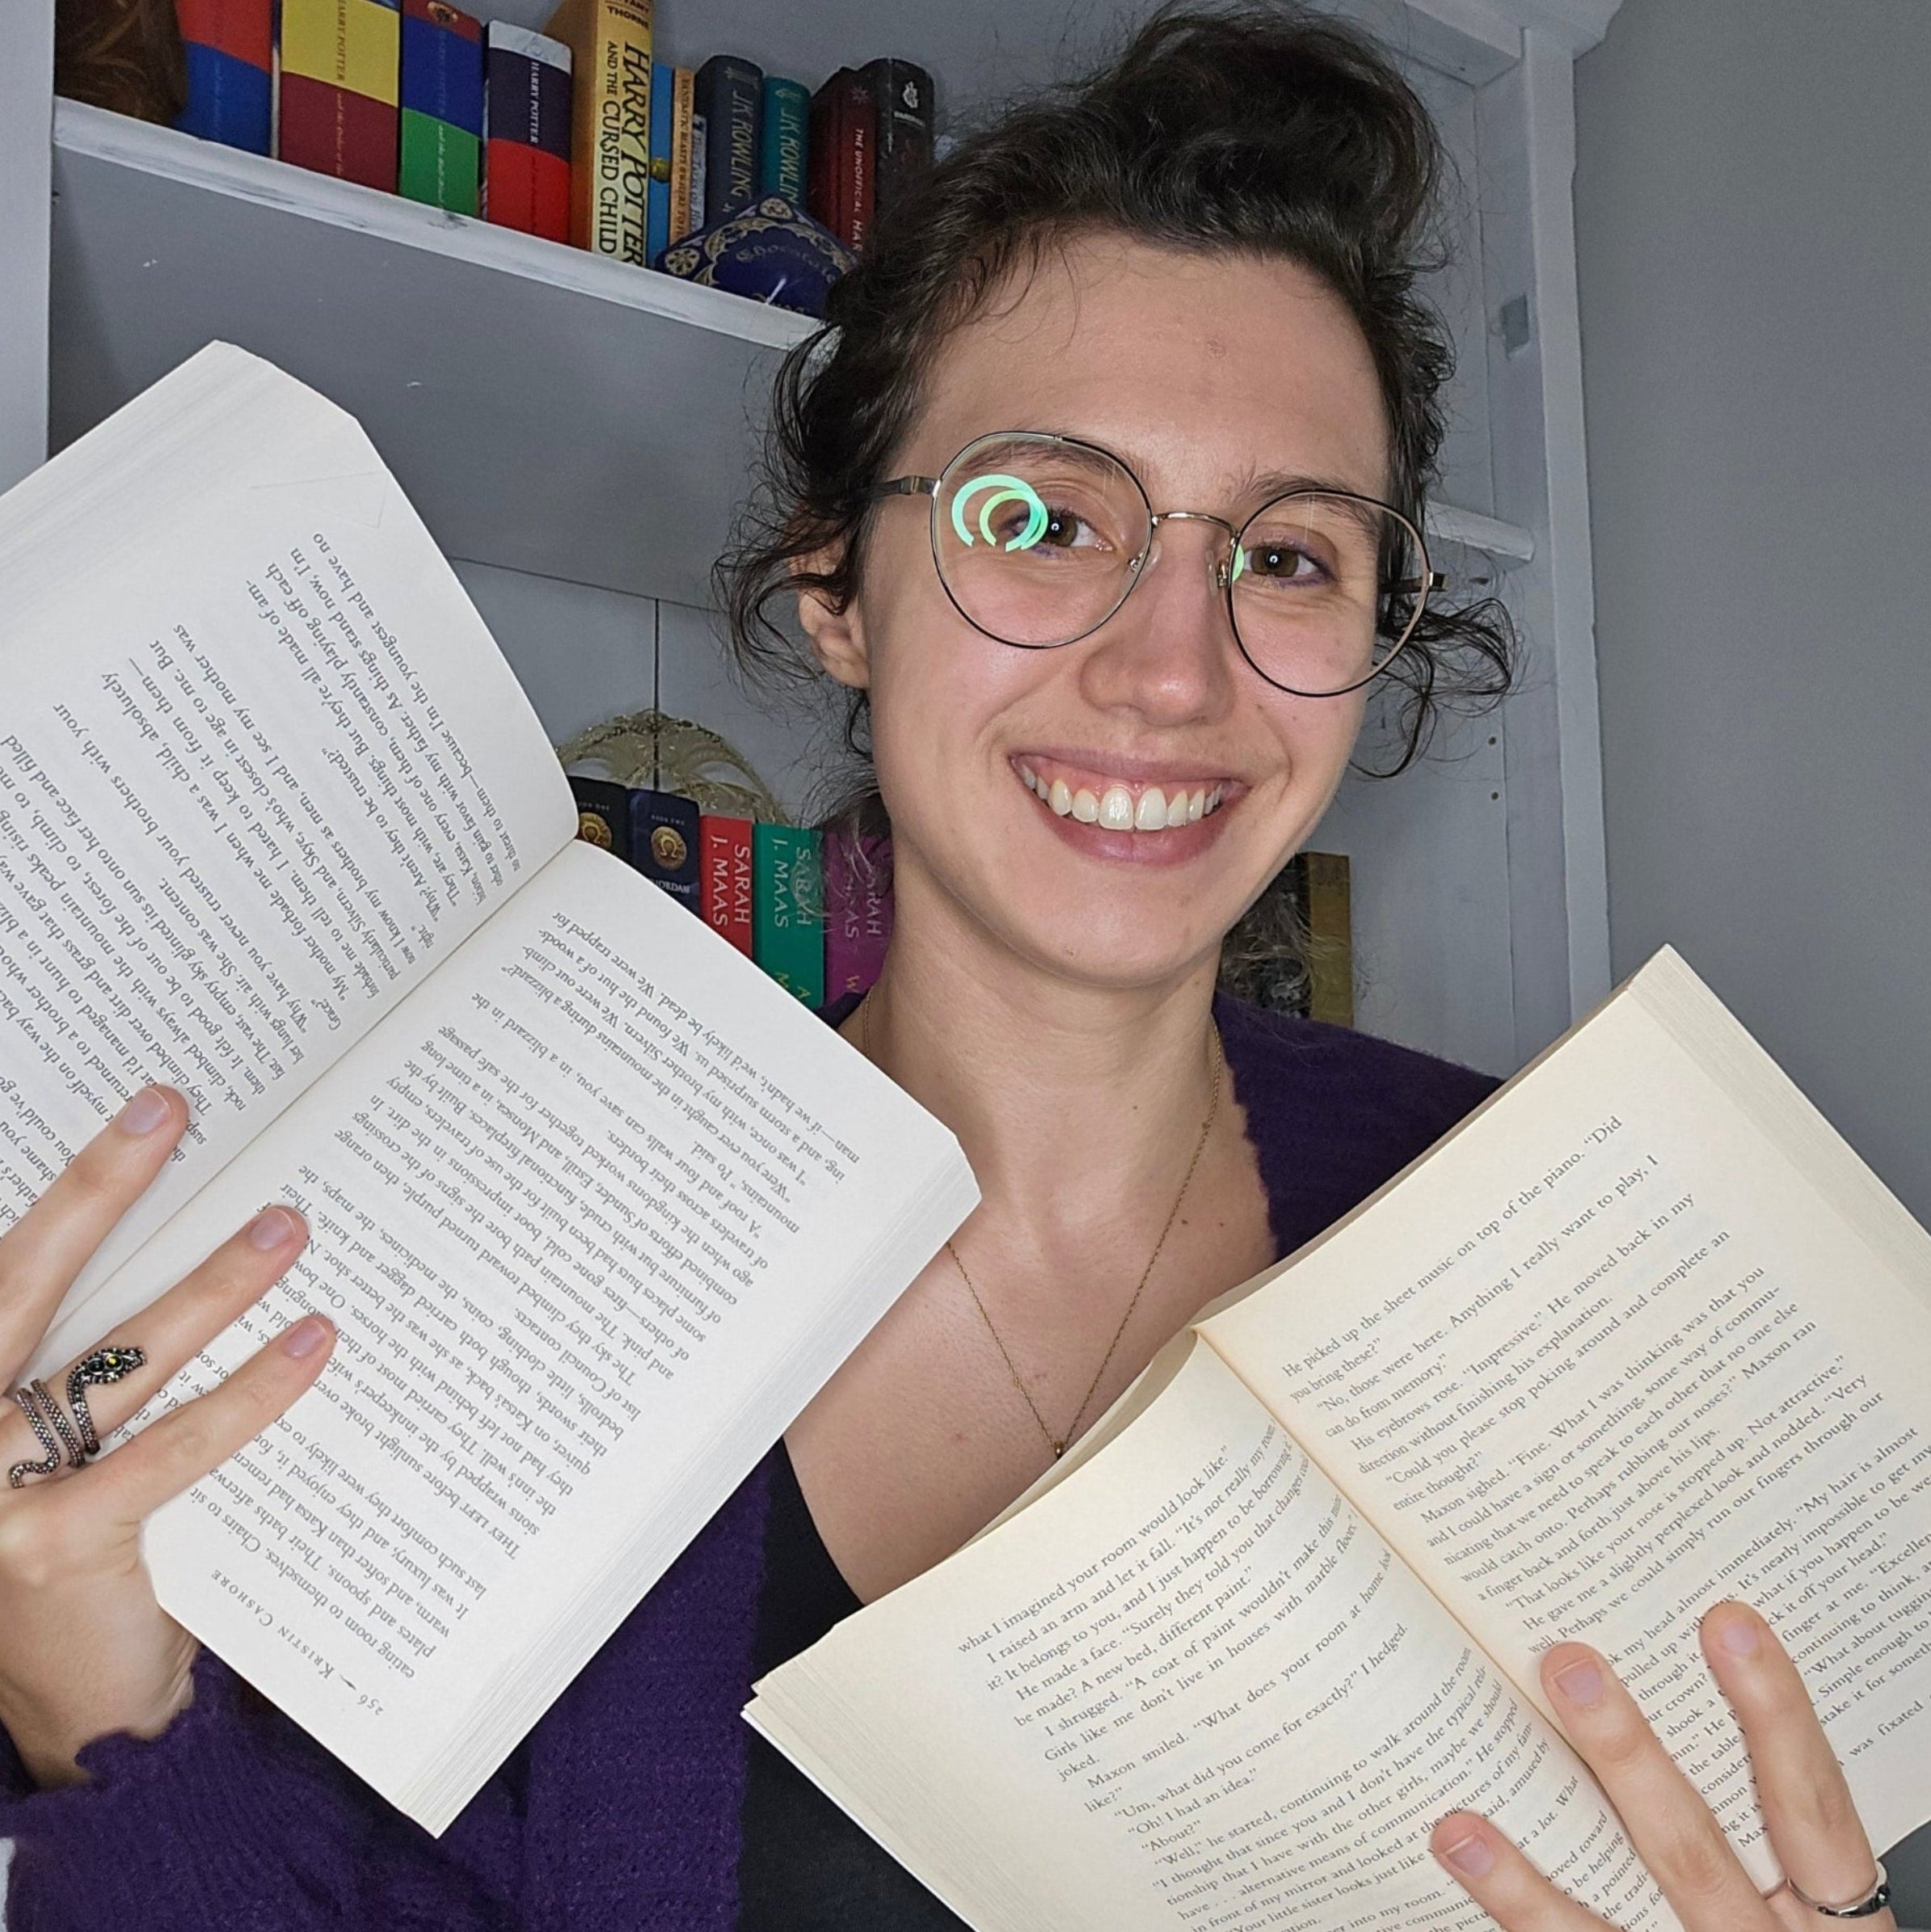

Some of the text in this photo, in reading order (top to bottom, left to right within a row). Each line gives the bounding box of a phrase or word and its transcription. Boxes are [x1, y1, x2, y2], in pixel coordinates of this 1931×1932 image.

[607, 6, 649, 30] THORNE
[336, 35, 346, 82] POTTER
[530, 61, 540, 144] HARRY POTTER
[622, 41, 650, 154] HARRY
[599, 40, 621, 254] AND THE CURSED CHILD
[731, 117, 753, 200] ROWLING
[854, 128, 864, 150] THE
[778, 135, 800, 204] ROWLIN
[854, 150, 863, 213] UNOFFICIAL
[621, 150, 647, 266] POTTER
[53, 704, 90, 738] your
[81, 739, 112, 774] with
[110, 775, 159, 836] brothers
[363, 795, 379, 818] be
[375, 813, 389, 829] to
[156, 834, 191, 867] your
[384, 829, 407, 855] they
[178, 867, 221, 913] trusted
[711, 835, 728, 926] J. MAAS
[735, 844, 750, 924] SARAH
[772, 838, 789, 928] J. MAAS
[795, 846, 812, 926] SARAH
[218, 913, 250, 947] never
[158, 877, 305, 1065] her lungs with air. She was content.
[247, 947, 273, 972] you
[265, 971, 290, 1002] have
[553, 995, 563, 1006] a
[559, 999, 598, 1036] during
[595, 1031, 654, 1081] mountains
[651, 1078, 672, 1097] the
[670, 1092, 685, 1110] in
[681, 1103, 719, 1135] caught
[716, 1133, 742, 1154] ever
[740, 1151, 766, 1173] you
[607, 1130, 769, 1269] of travelers across their borders.
[334, 1130, 636, 1387] The sky they climbed toward turned purple, then orange
[1281, 1363, 1303, 1377] He
[1302, 1337, 1342, 1370] picked
[1341, 1328, 1360, 1343] up
[1360, 1313, 1382, 1330] the
[1383, 1287, 1417, 1314] sheet
[1417, 1256, 1455, 1289] music
[1457, 1241, 1477, 1257] on
[1476, 1220, 1501, 1240] top
[1502, 1199, 1519, 1220] of
[1518, 1185, 1542, 1206] the
[1542, 1153, 1586, 1189] piano.
[1350, 1436, 1376, 1451] His
[1377, 1402, 1431, 1438] eyebrows
[1432, 1382, 1464, 1403] rose.
[1546, 1295, 1572, 1314] He
[1573, 1254, 1618, 1295] moved
[1615, 1230, 1652, 1257] back
[1650, 1215, 1670, 1230] in
[1670, 1193, 1694, 1216] my
[514, 1307, 642, 1423] list of Council contacts.
[1358, 1297, 1613, 1474] direction without finishing his explanation.
[1326, 1424, 1346, 1437] can
[1344, 1415, 1361, 1428] do
[1359, 1398, 1392, 1419] from
[958, 1630, 993, 1652] what
[991, 1622, 1003, 1635] I
[1001, 1583, 1067, 1629] imagined
[1066, 1563, 1099, 1592] your
[1101, 1537, 1138, 1567] room
[1137, 1500, 1179, 1538] would
[1175, 1477, 1206, 1506] look
[357, 1694, 384, 1715] 256
[1156, 1782, 1191, 1802] what
[1192, 1767, 1216, 1786] did
[1216, 1755, 1243, 1776] you
[1246, 1732, 1281, 1758] come
[1282, 1718, 1303, 1736] for
[1360, 1663, 1371, 1675] I
[1367, 1622, 1408, 1668] hedged.
[1056, 1753, 1100, 1782] joked.
[1164, 1812, 1174, 1821] I
[1173, 1798, 1202, 1817] had
[1203, 1792, 1221, 1804] an
